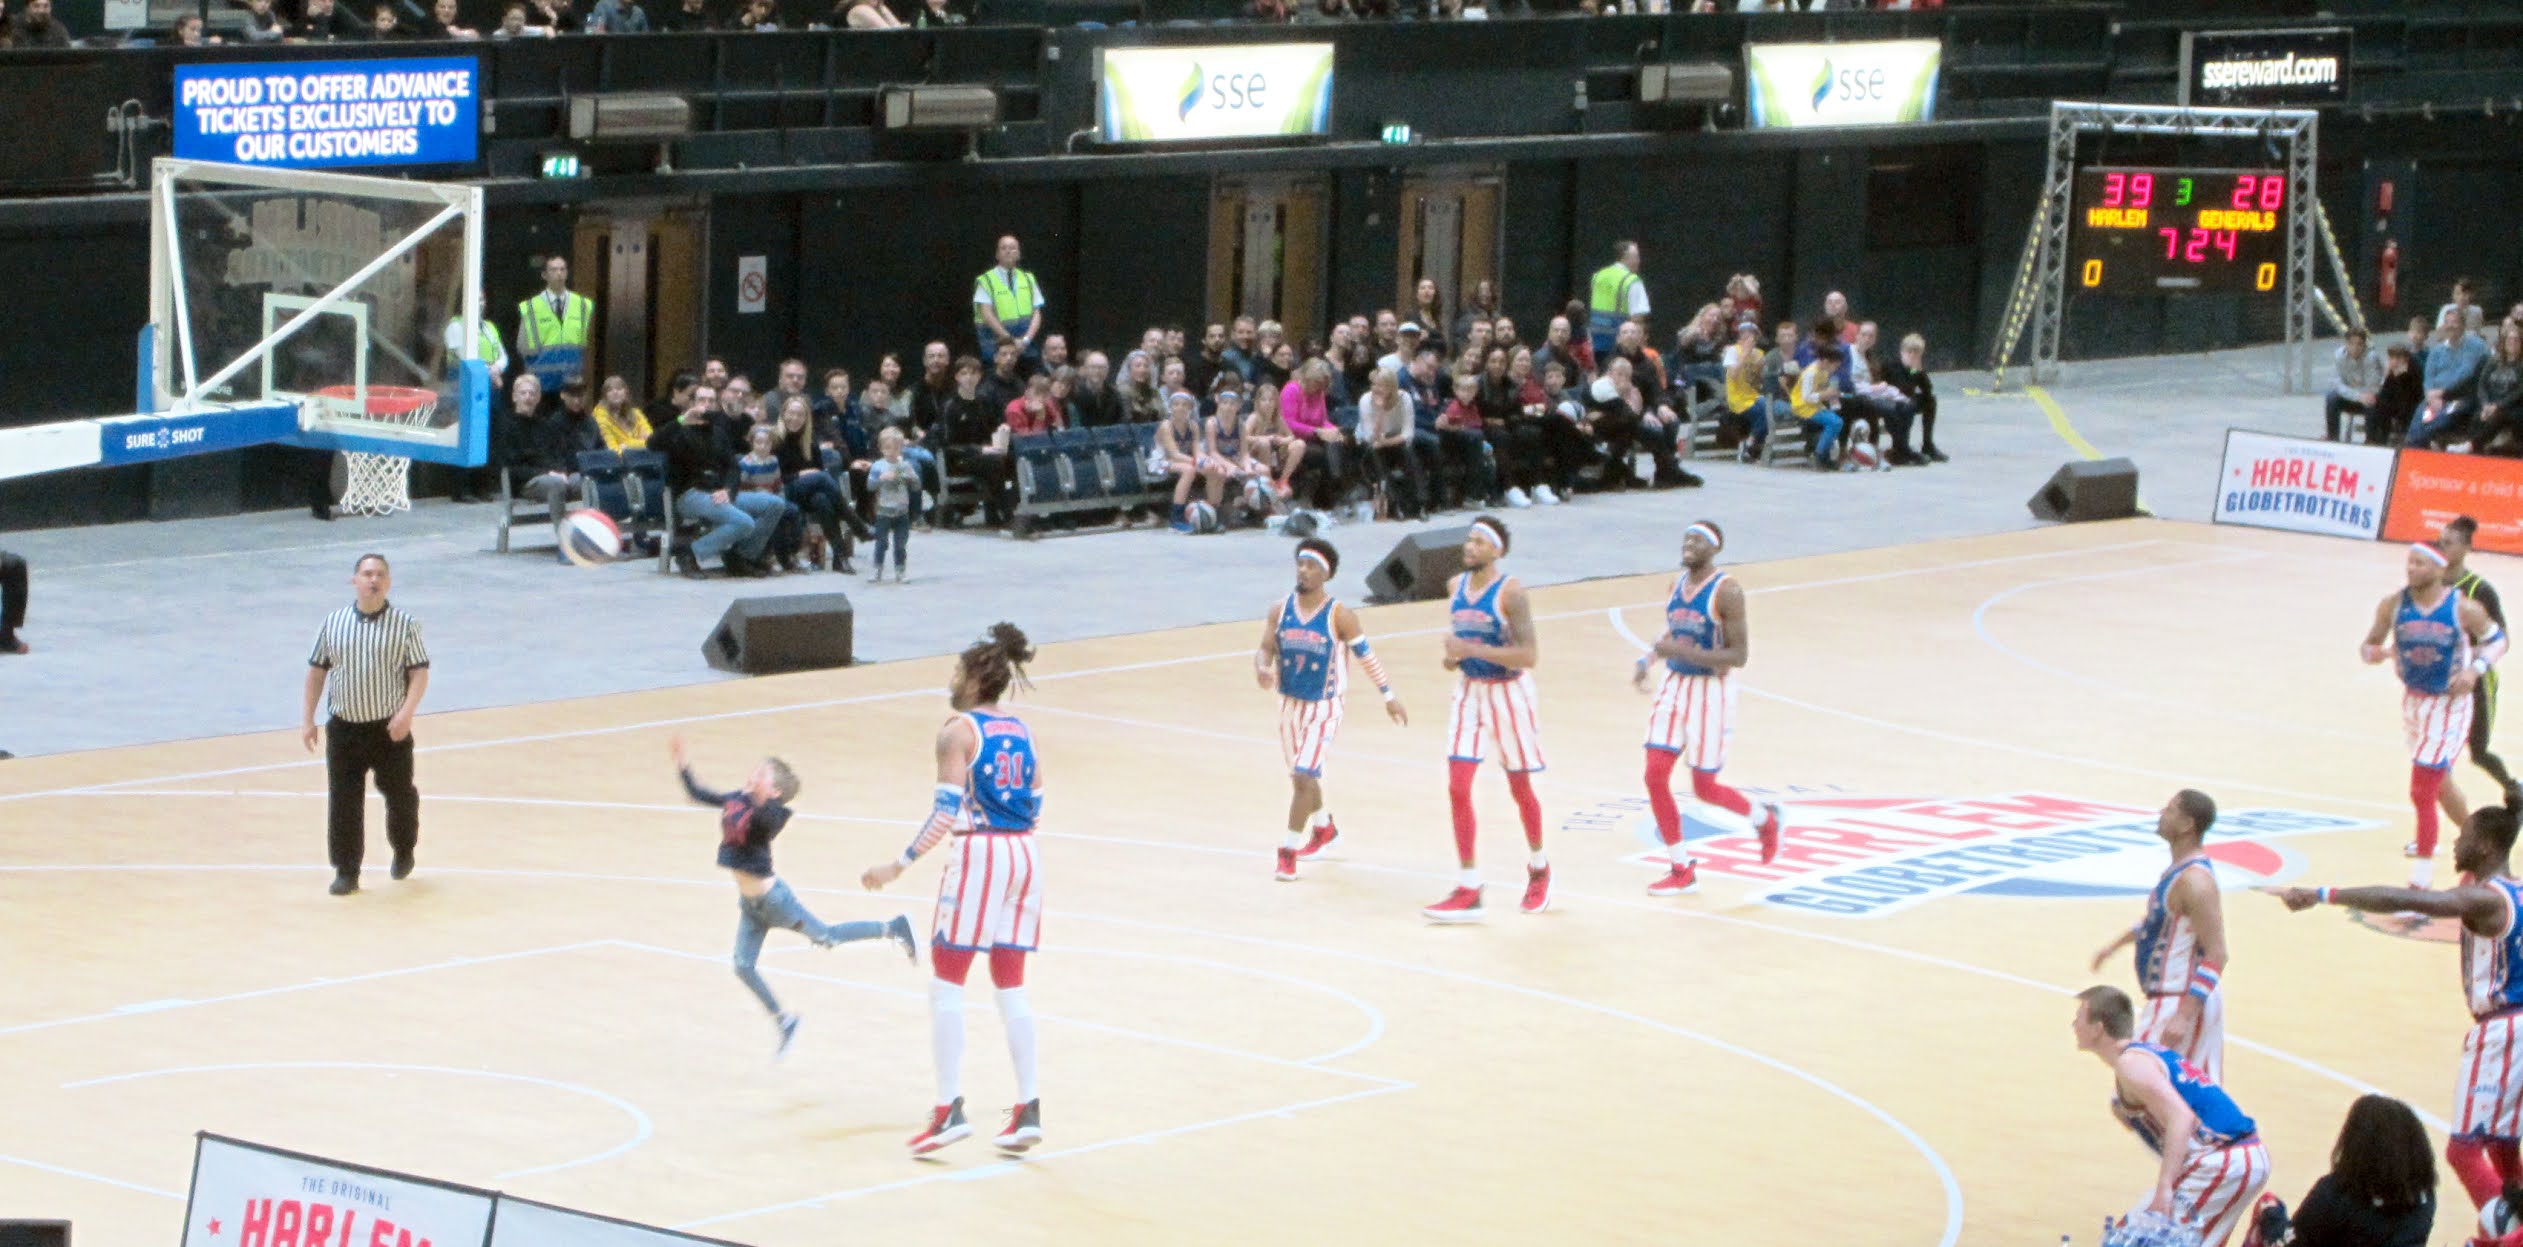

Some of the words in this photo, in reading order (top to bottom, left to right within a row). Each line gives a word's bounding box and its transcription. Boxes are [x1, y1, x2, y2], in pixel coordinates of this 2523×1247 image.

[1839, 68, 1885, 101] sse
[2203, 52, 2337, 89] ssereward.com
[183, 79, 262, 106] PROUD
[266, 77, 297, 101] TO
[300, 74, 367, 101] OFFER
[371, 71, 470, 99] ADVANCE
[1212, 72, 1266, 110] sse
[196, 105, 285, 134] TICKETS
[289, 101, 421, 132] EXCLUSIVELY
[425, 99, 456, 125] TO
[235, 133, 286, 161] OUR
[289, 128, 418, 158] CUSTOMERS
[2103, 172, 2154, 208] 39
[2175, 177, 2193, 206] 3
[2232, 175, 2284, 210] 28
[2087, 207, 2148, 228] HARLEM
[2198, 209, 2276, 231] GENERALS
[2082, 258, 2103, 288] 0
[2256, 261, 2277, 291] 0
[125, 432, 156, 450] SURE
[171, 427, 205, 445] SHOT
[2251, 458, 2360, 499] HARLEM
[2408, 469, 2464, 491] Sponsor
[2481, 480, 2515, 497] child
[2225, 490, 2373, 530] GLOBETROTTERS
[994, 750, 1024, 790] 31
[1639, 794, 2164, 881] HARLEM
[300, 1176, 325, 1194] THE
[331, 1180, 392, 1212] ORIGINAL
